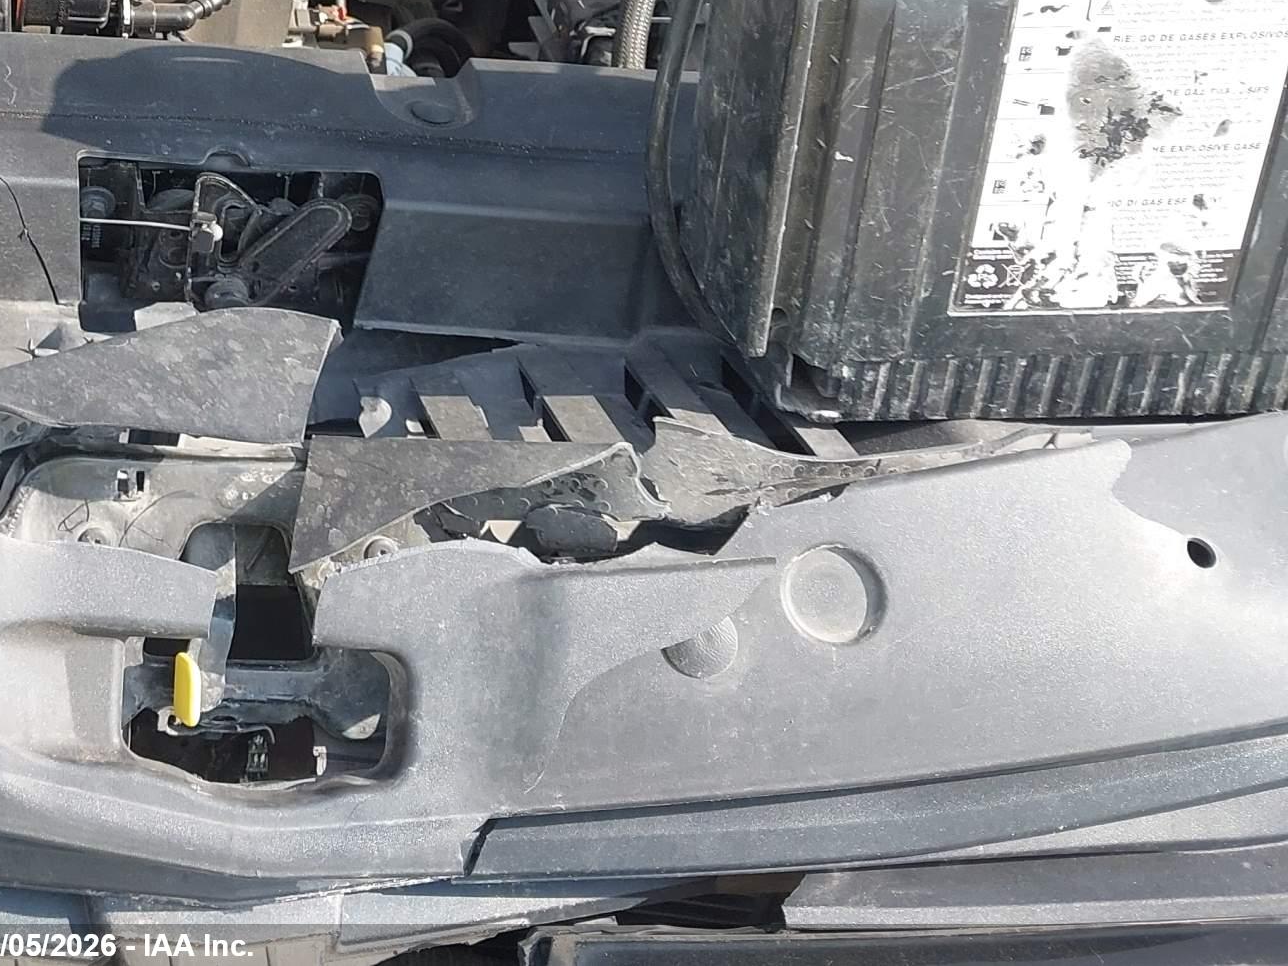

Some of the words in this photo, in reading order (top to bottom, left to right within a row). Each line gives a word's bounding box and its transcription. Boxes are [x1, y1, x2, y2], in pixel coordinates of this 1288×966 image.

[1113, 34, 1156, 43] RIEGO
[1160, 34, 1174, 42] DE
[1180, 32, 1216, 42] GASES
